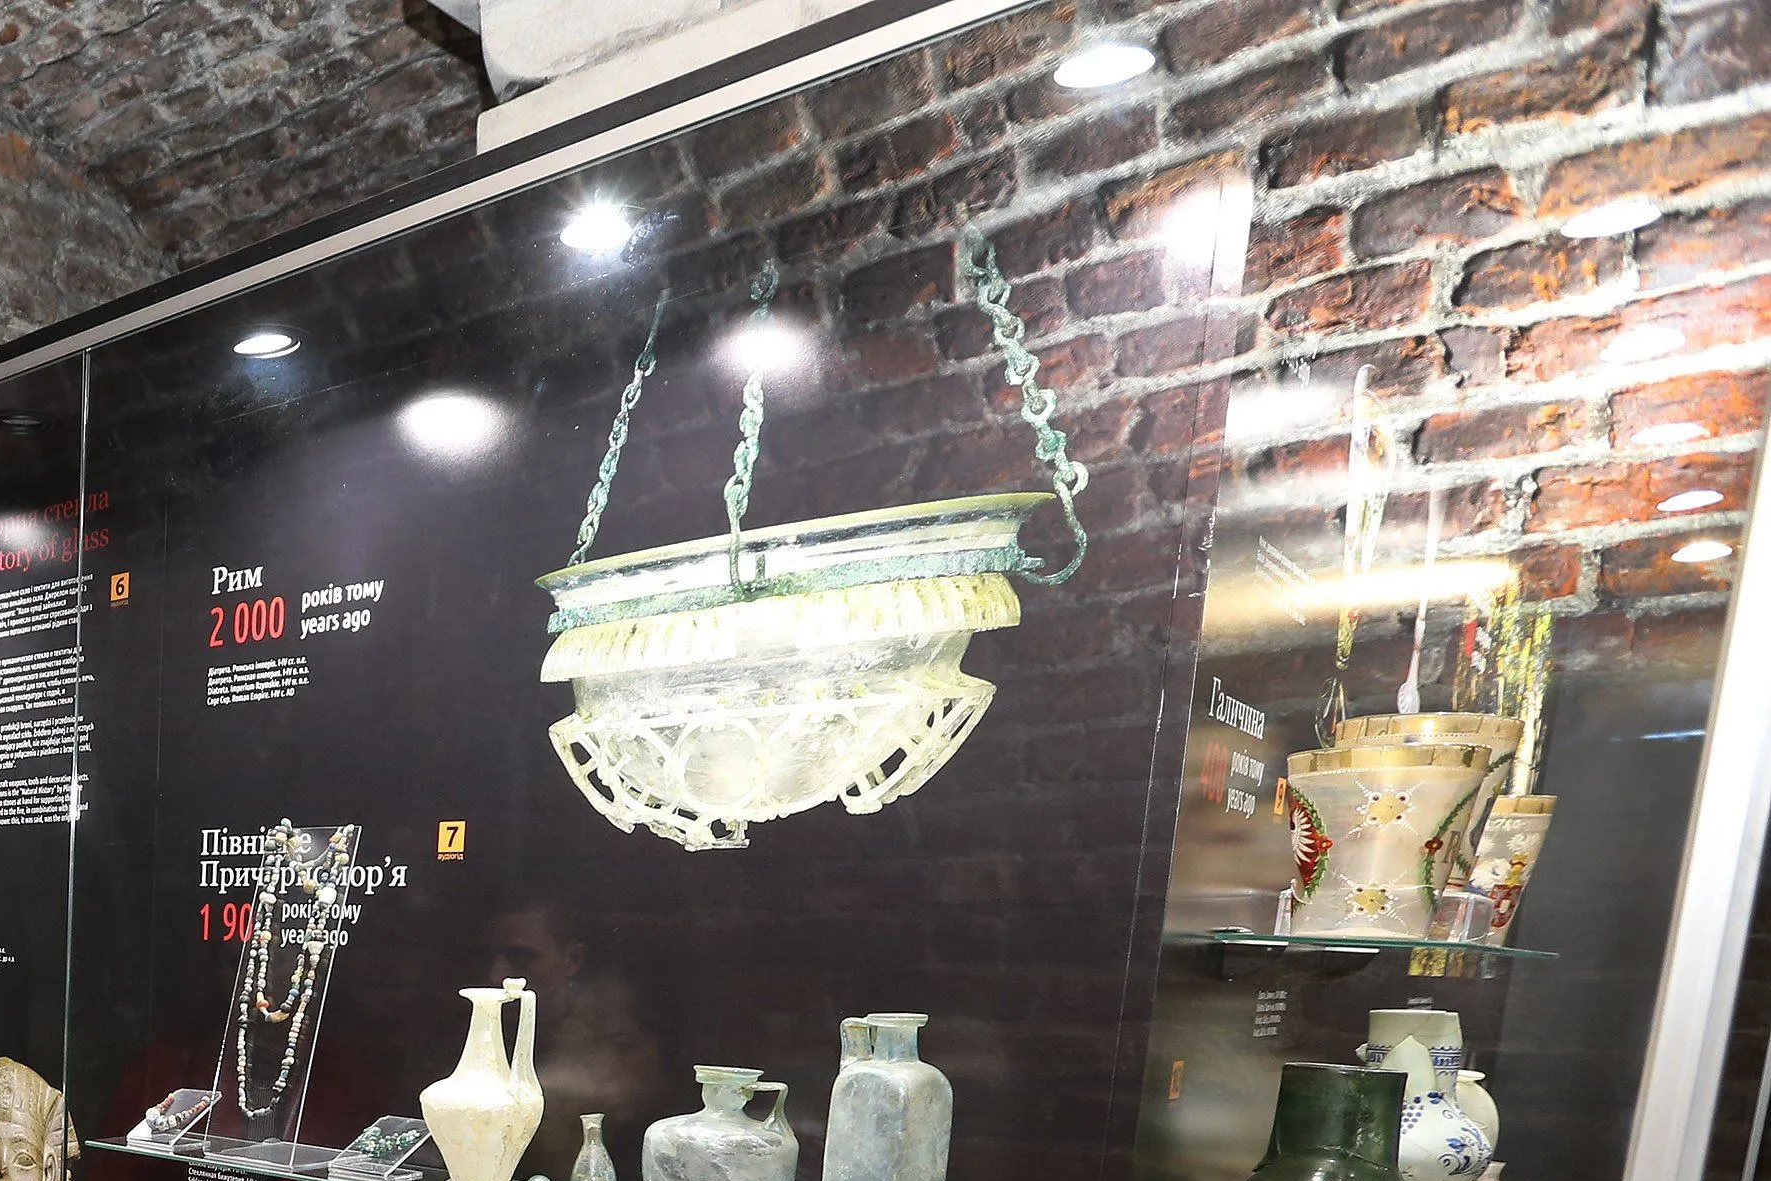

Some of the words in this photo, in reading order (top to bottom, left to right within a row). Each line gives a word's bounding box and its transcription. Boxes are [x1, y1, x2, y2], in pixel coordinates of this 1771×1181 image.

[44, 491, 109, 522] стела
[40, 537, 58, 560] of
[116, 577, 125, 596] 6
[212, 566, 263, 594] Рим
[301, 583, 342, 613] років
[345, 579, 384, 602] тому
[209, 607, 225, 647] 2
[234, 596, 286, 644] 000
[300, 612, 340, 640] years
[342, 608, 371, 632] ago
[1209, 676, 1265, 740] Галичина
[1231, 749, 1249, 777] років
[1250, 758, 1265, 787] тому
[200, 826, 312, 856] Півніе
[446, 826, 459, 848] 7
[200, 903, 210, 941] 1
